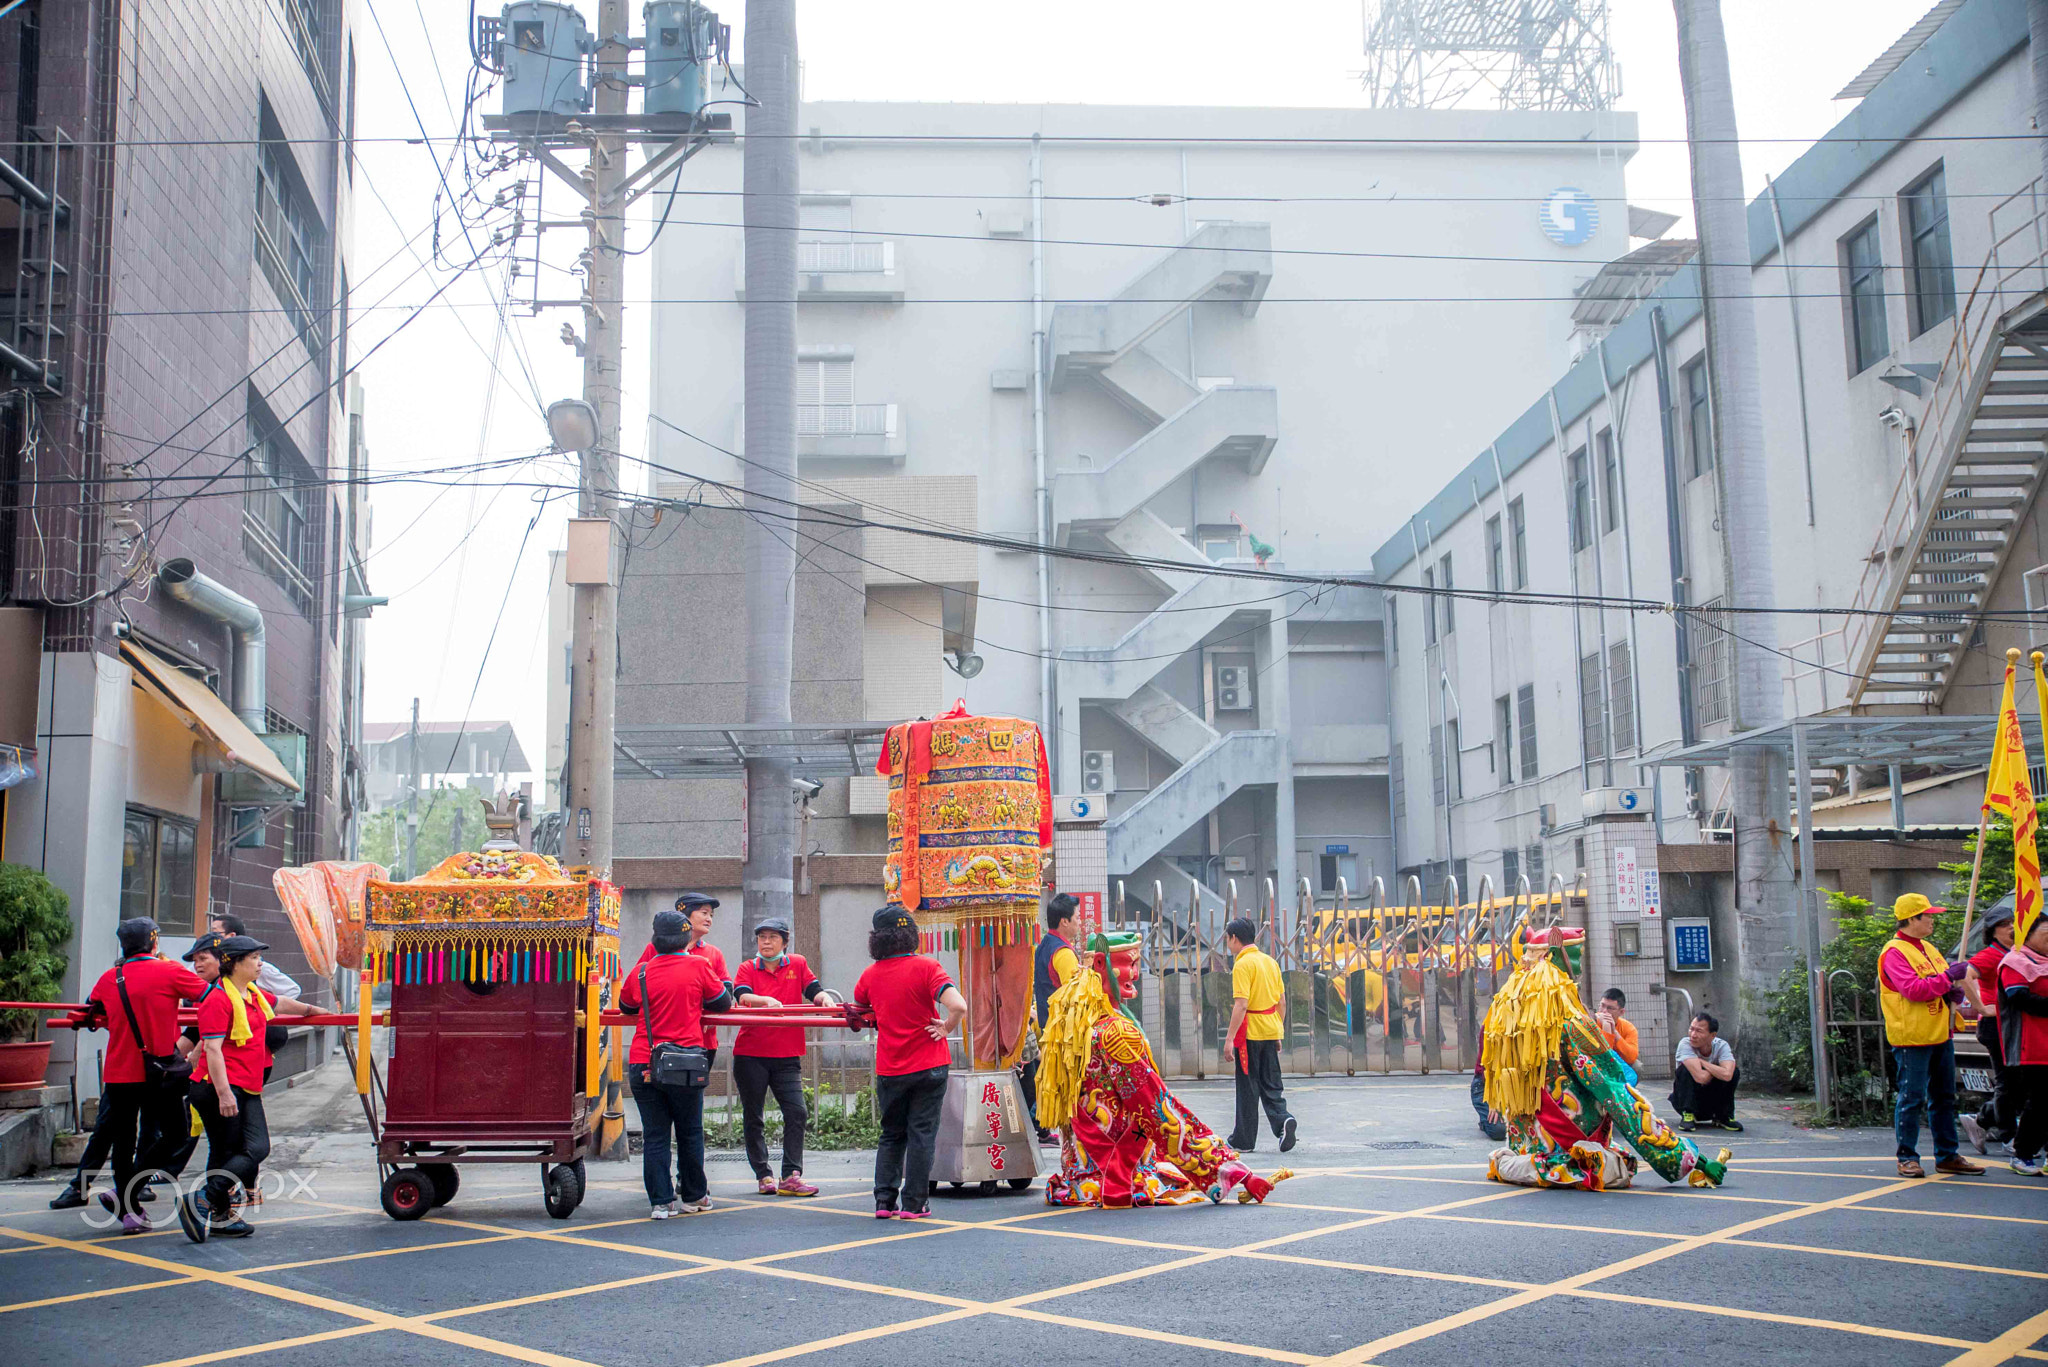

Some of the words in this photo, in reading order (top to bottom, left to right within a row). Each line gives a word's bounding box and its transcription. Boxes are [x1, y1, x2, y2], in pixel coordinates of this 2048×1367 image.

[579, 827, 591, 837] 19
[1627, 863, 1636, 906] 禁止入內
[981, 1081, 1006, 1170] 廣寧宮
